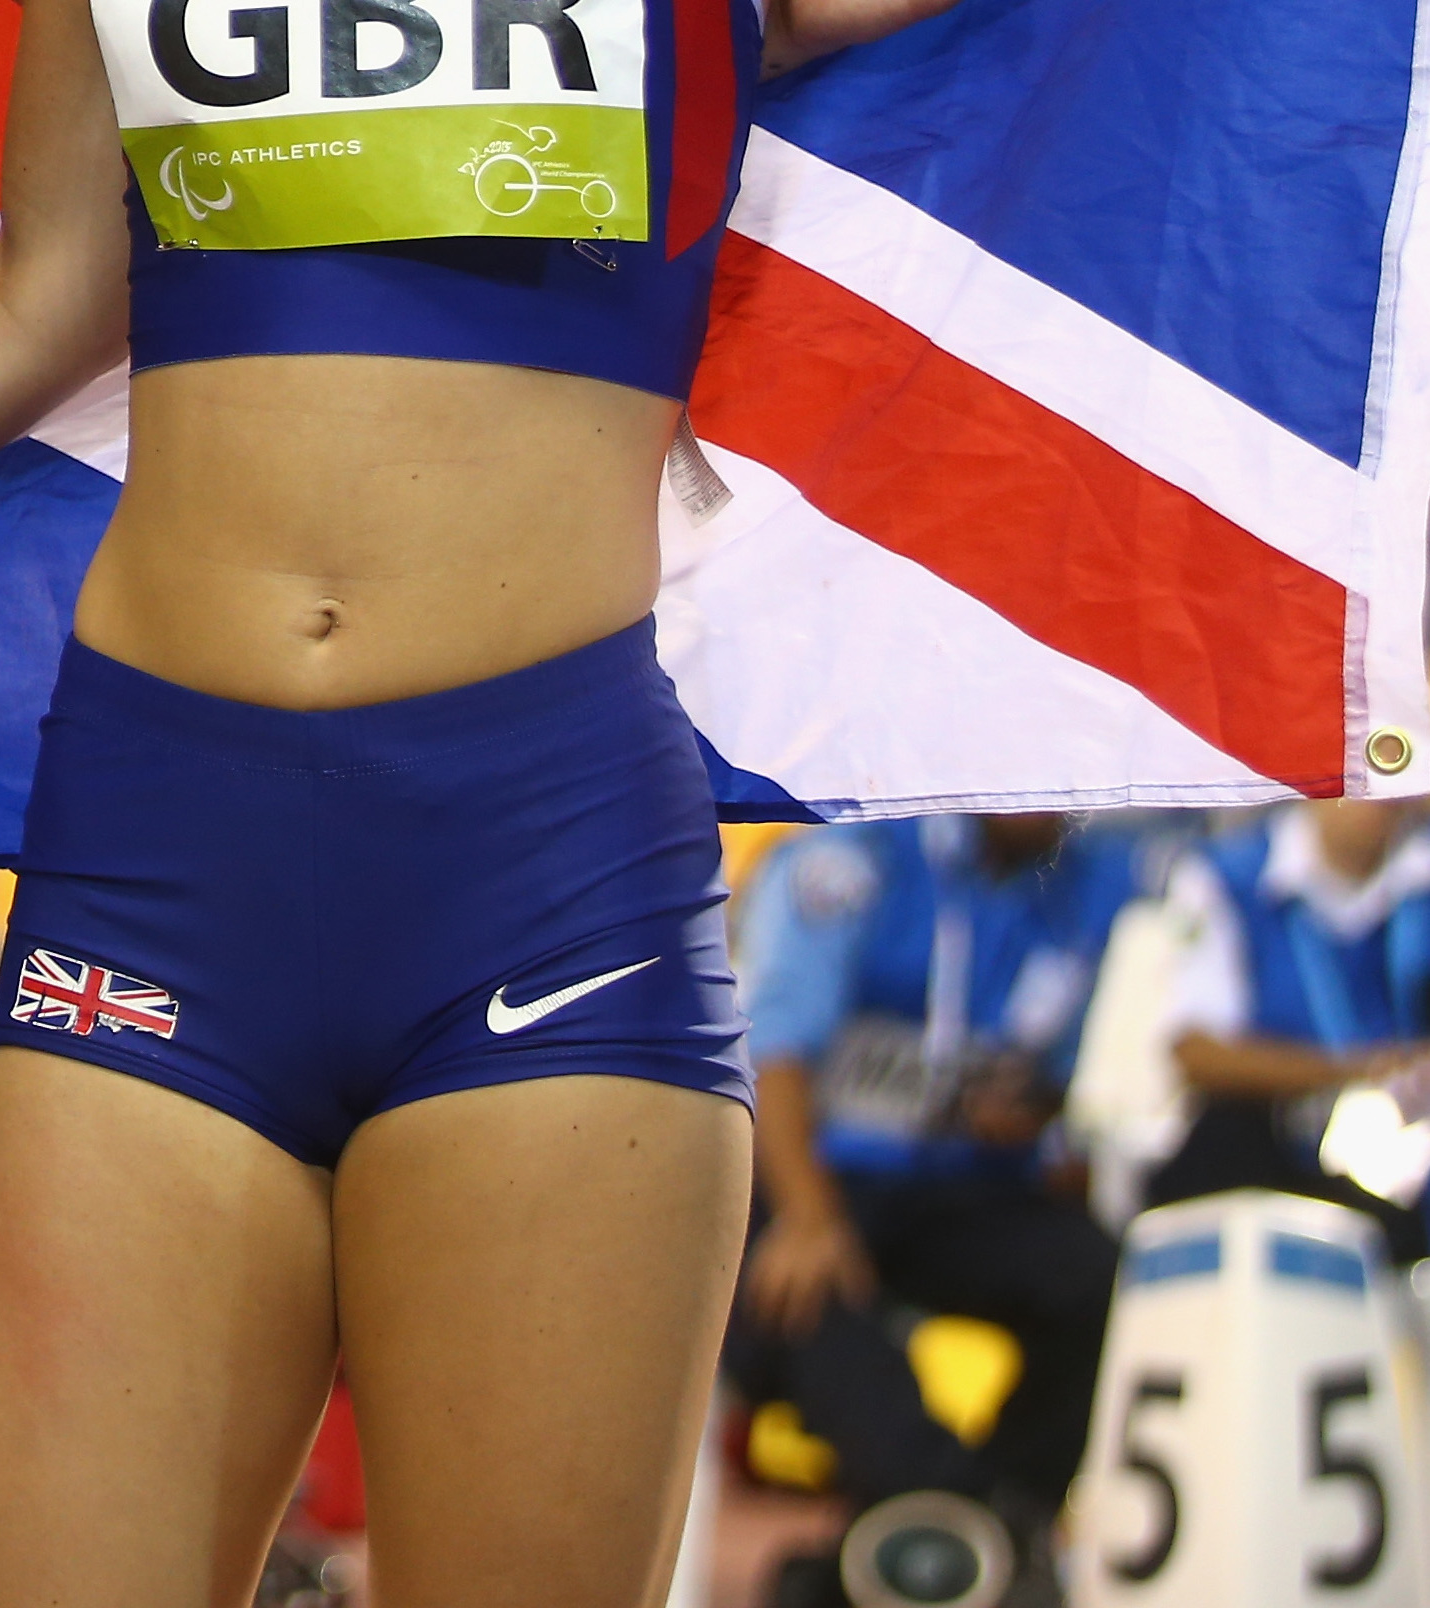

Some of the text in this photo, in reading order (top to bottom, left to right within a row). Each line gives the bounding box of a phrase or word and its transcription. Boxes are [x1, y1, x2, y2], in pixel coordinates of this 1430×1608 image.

[192, 139, 362, 167] IPC ATHLETICS
[1107, 1374, 1186, 1586] 5
[1305, 1366, 1386, 1589] 5
